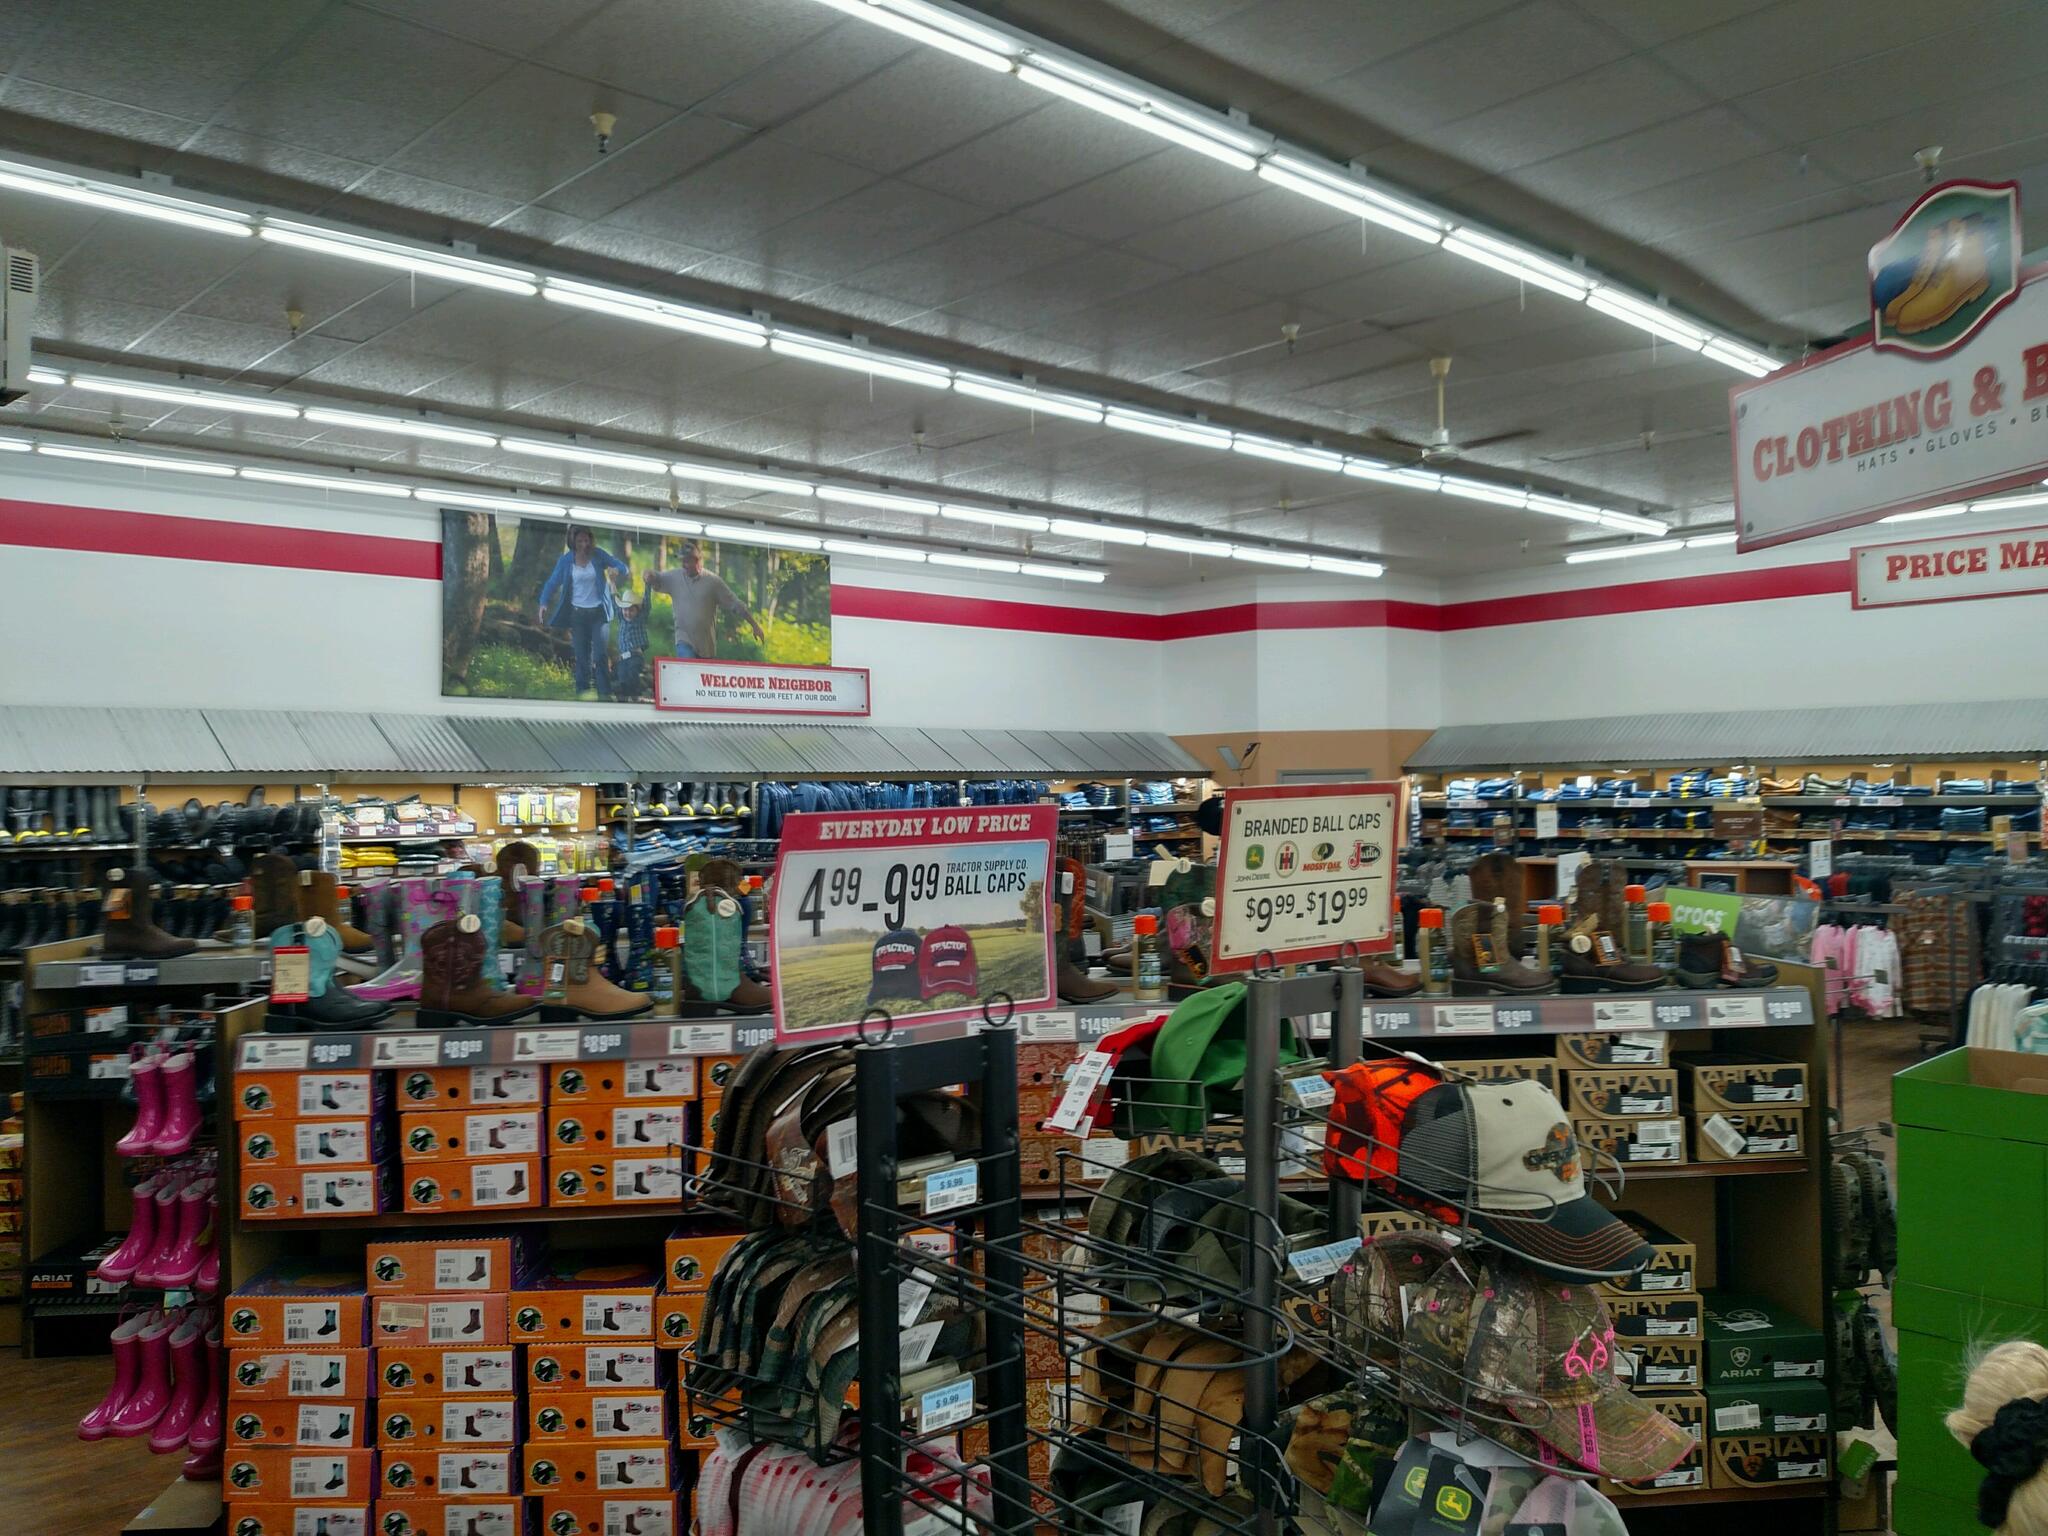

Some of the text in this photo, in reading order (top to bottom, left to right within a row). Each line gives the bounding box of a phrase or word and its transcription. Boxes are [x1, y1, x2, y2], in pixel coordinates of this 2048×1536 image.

[1753, 379, 1952, 483] CLOTHING
[1969, 365, 2004, 417] &
[1857, 449, 1898, 473] HATS
[1926, 420, 1998, 453] GLOVES
[1886, 547, 1987, 582] PRICE
[700, 673, 833, 692] WELCOME NEIGHBOR
[695, 689, 706, 698] NO
[707, 690, 727, 698] NEED
[729, 690, 738, 698] TO
[739, 691, 757, 699] WIPE
[758, 692, 776, 700] YOUR
[777, 693, 794, 701] FEET
[804, 694, 819, 702] OUR
[819, 813, 1031, 841] EVERYDAY LOW PRICE
[1244, 813, 1381, 838] BRANDED BALL CAPS
[946, 859, 1028, 874] TRACTOR SUPPLY CO.
[1302, 863, 1328, 872] MOSSY
[944, 872, 1026, 896] BALL CAPS
[1675, 905, 1723, 929] crocs
[32, 1274, 73, 1282] ARIAT
[1720, 1368, 1762, 1378] ARIAT
[1719, 1437, 1825, 1458] ARIAT
